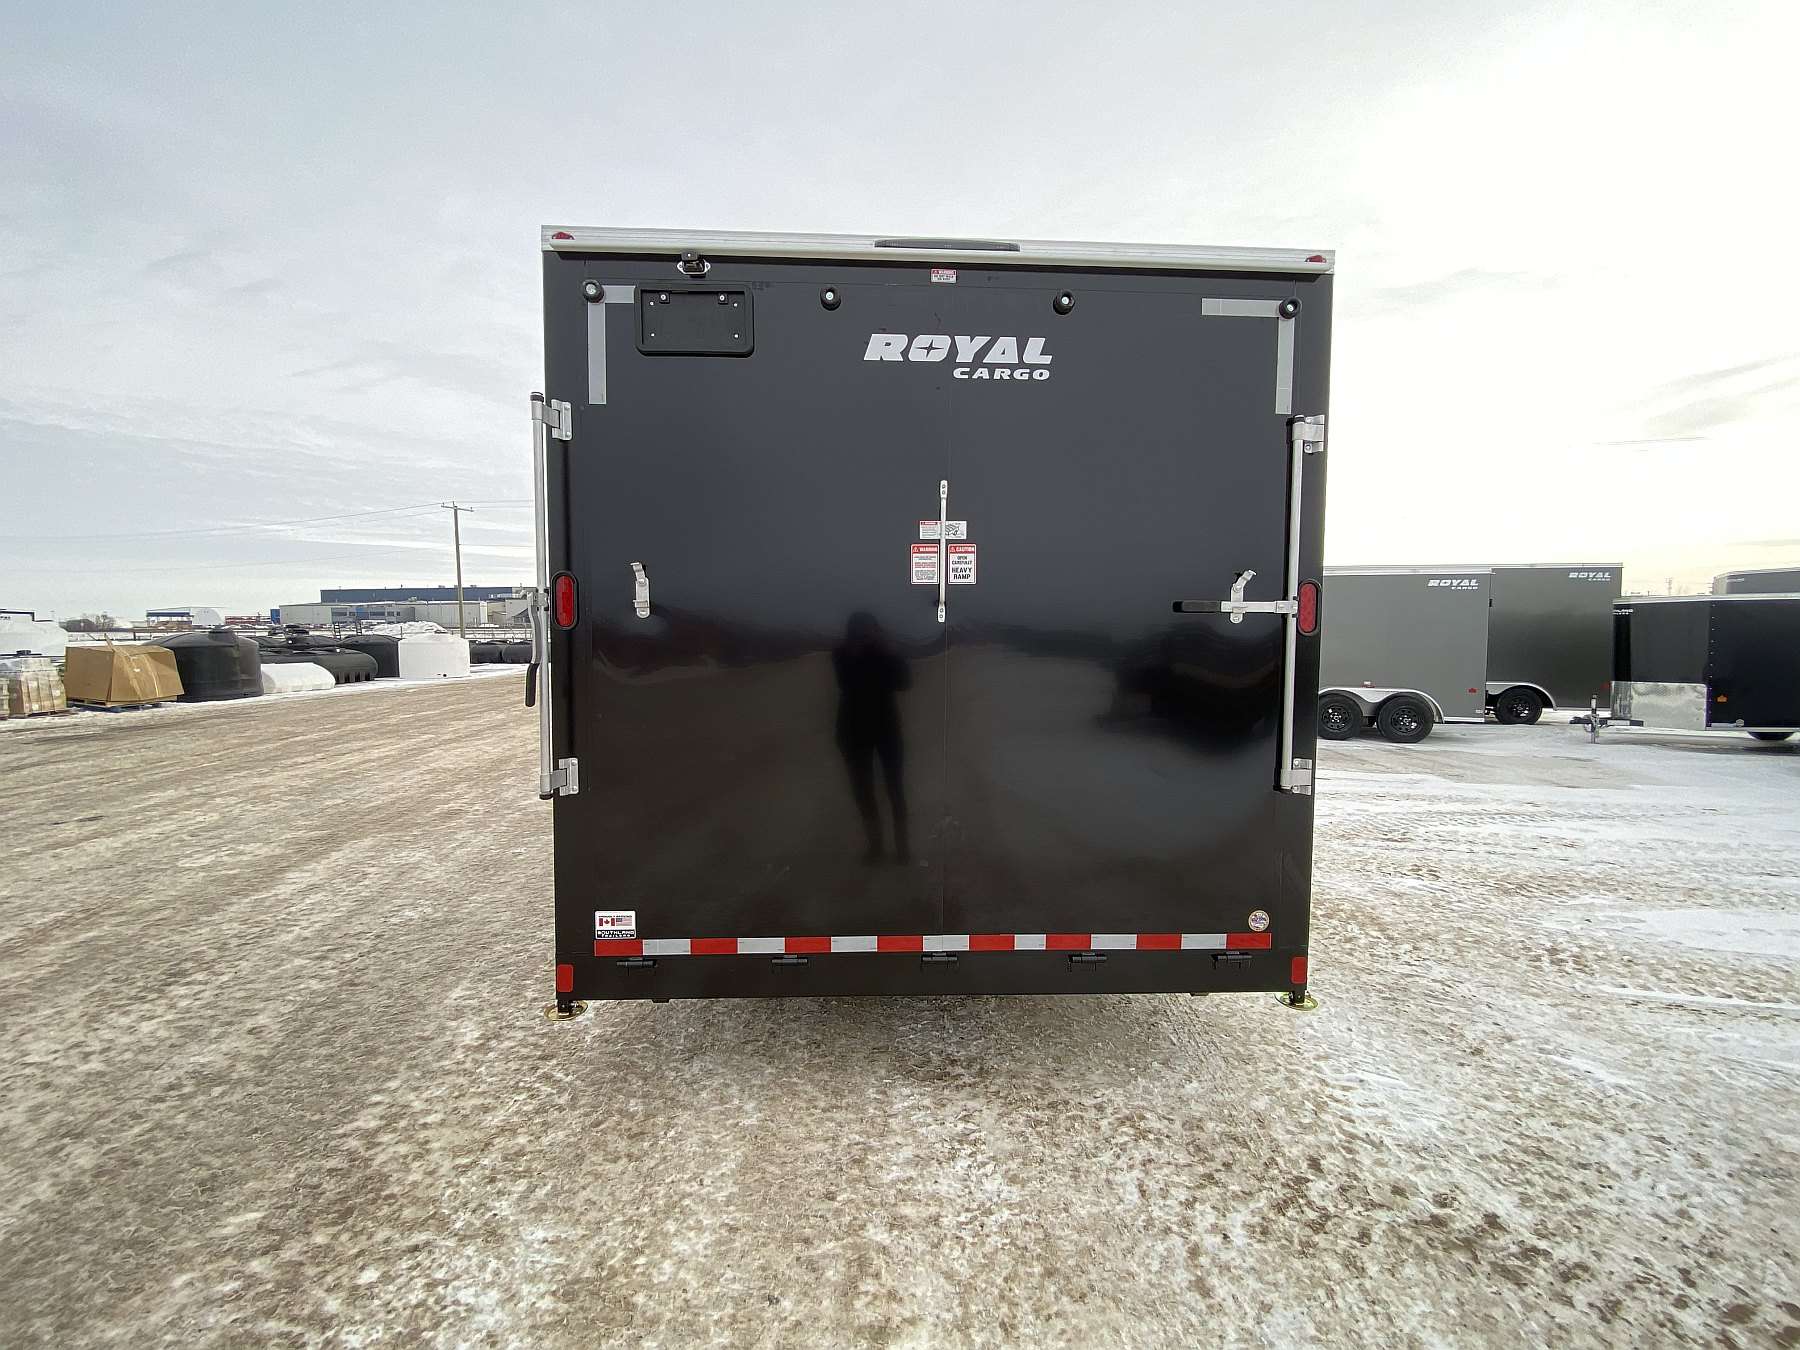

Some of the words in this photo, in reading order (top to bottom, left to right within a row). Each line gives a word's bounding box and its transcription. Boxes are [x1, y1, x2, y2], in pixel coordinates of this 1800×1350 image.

[863, 333, 1053, 365] ROYAL
[953, 367, 1050, 381] CARGO
[1427, 579, 1479, 587] ROYAL
